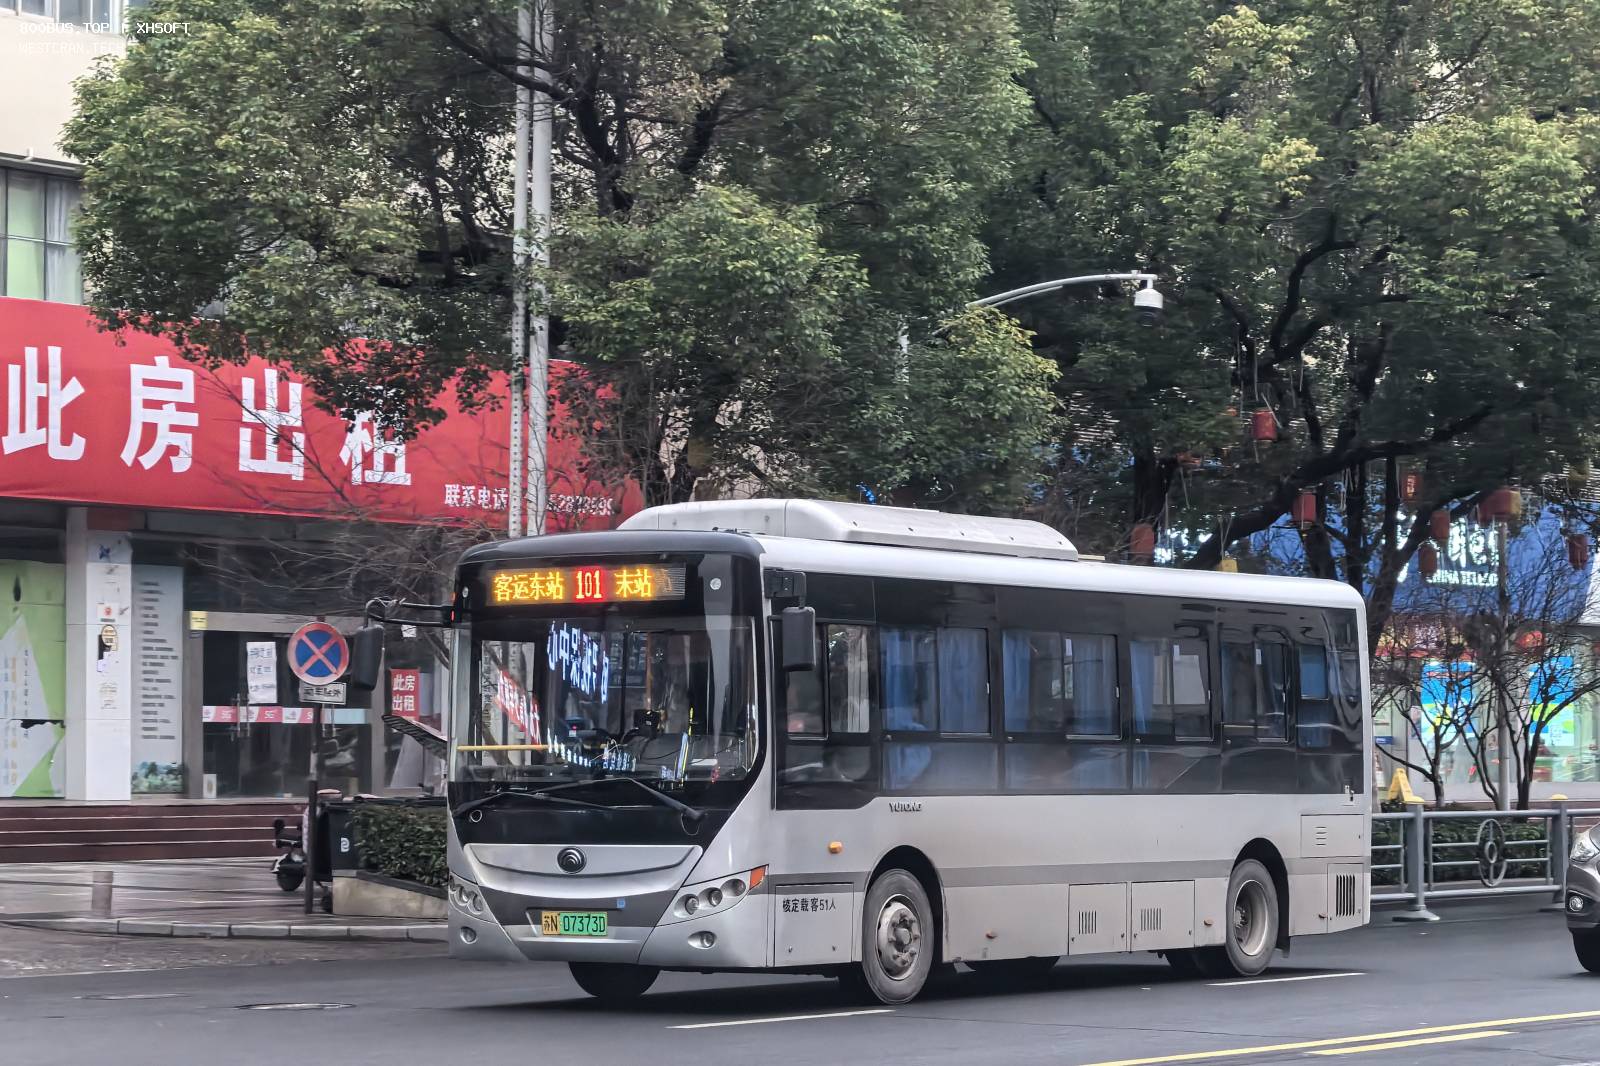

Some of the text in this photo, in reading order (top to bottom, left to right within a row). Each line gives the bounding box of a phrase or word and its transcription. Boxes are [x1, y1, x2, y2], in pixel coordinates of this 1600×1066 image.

[2, 346, 412, 486] 此房出租
[444, 484, 508, 510] 联系电话
[494, 568, 653, 602] 客运东站 101 末站
[1460, 571, 1499, 587] TELECO
[393, 674, 416, 691] 此房
[392, 694, 415, 711] 出租
